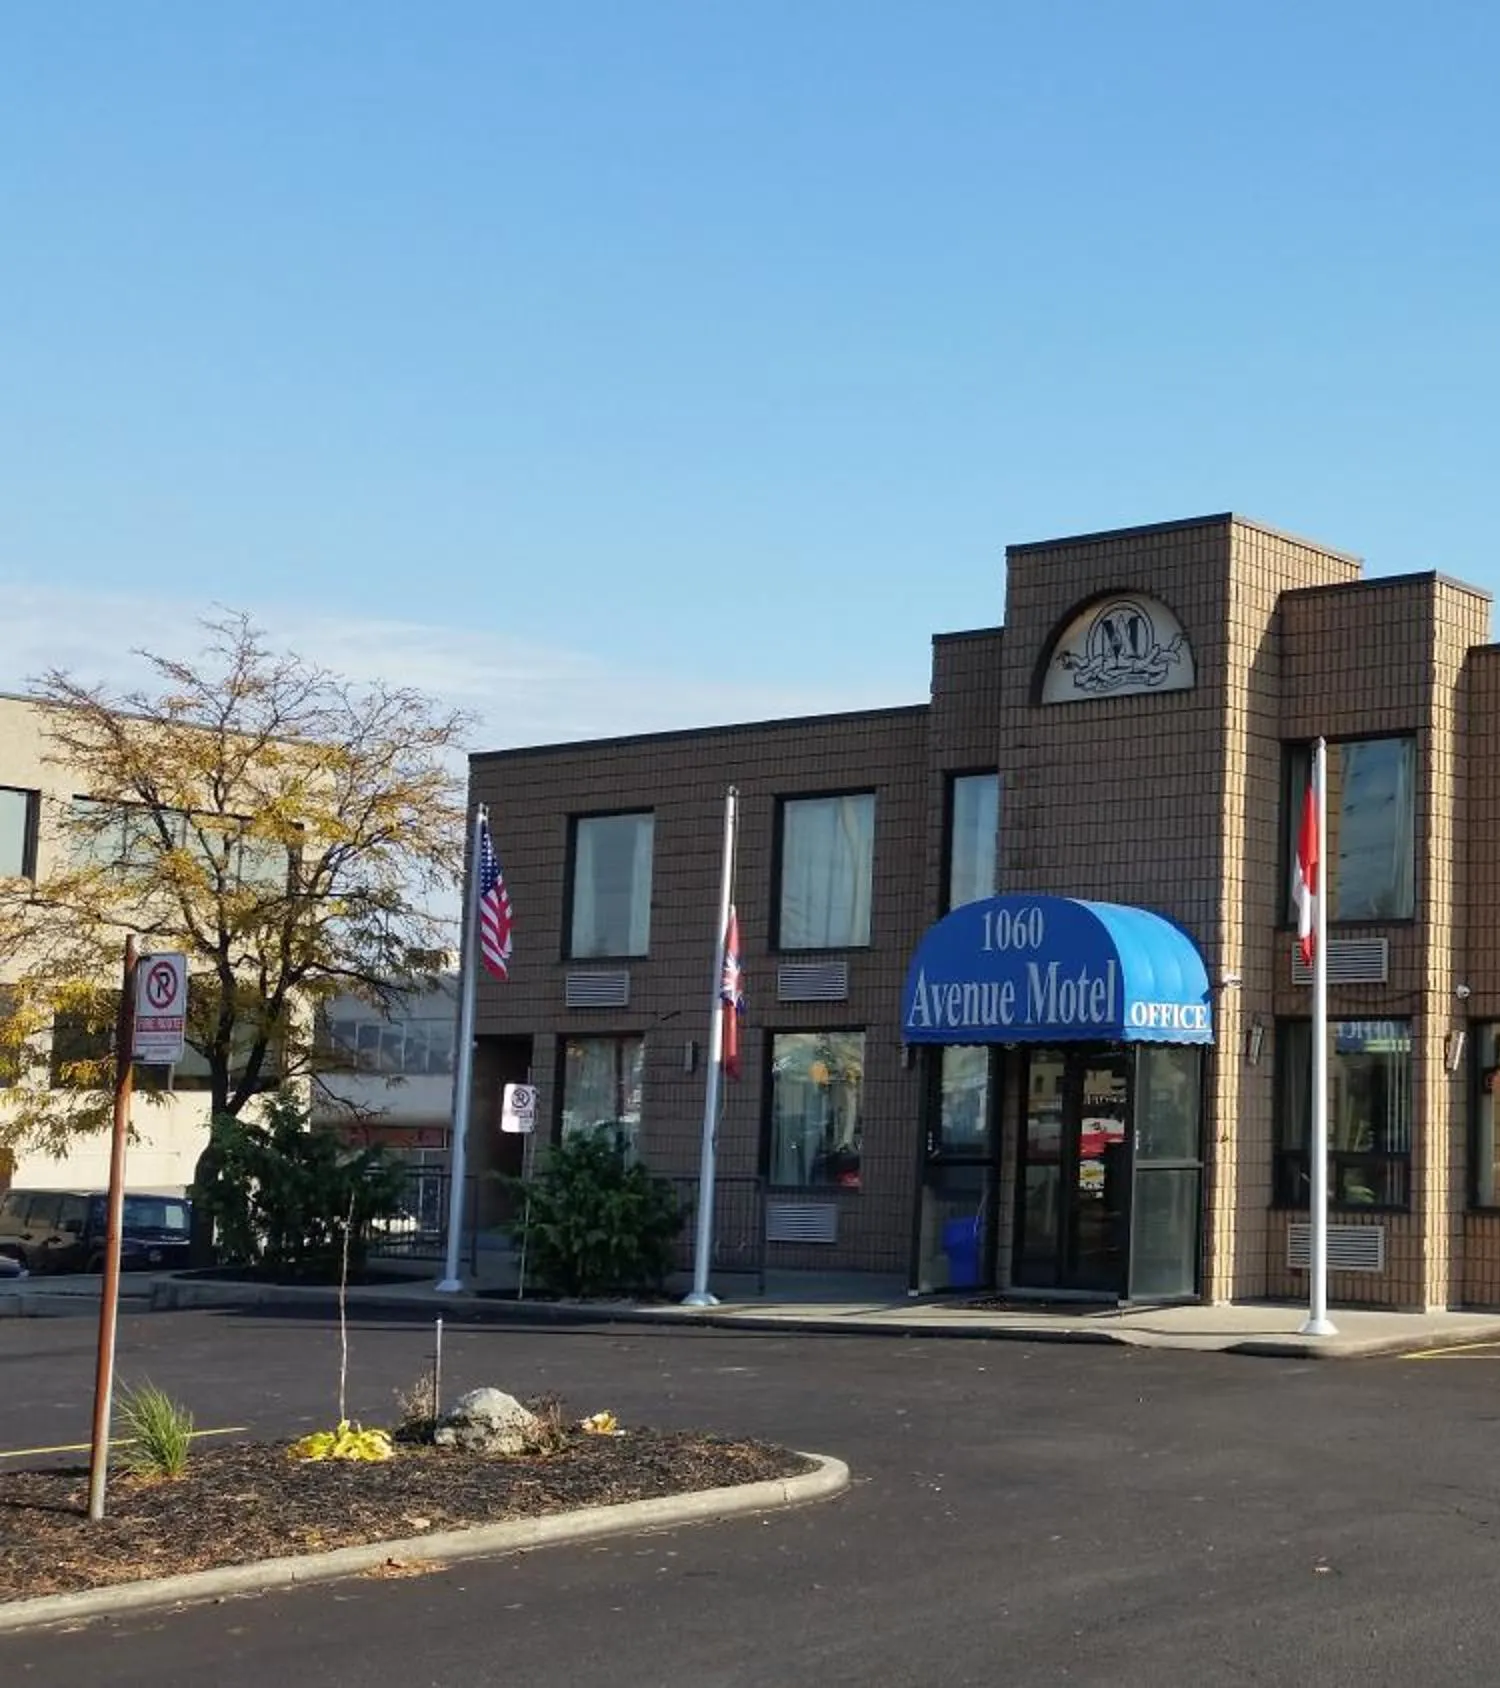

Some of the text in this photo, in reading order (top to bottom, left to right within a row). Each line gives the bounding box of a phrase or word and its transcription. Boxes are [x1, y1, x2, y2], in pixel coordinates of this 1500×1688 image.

[982, 907, 1044, 951] 1060
[907, 960, 1116, 1026] Avenue Motel
[1130, 1001, 1207, 1028] OFFICE
